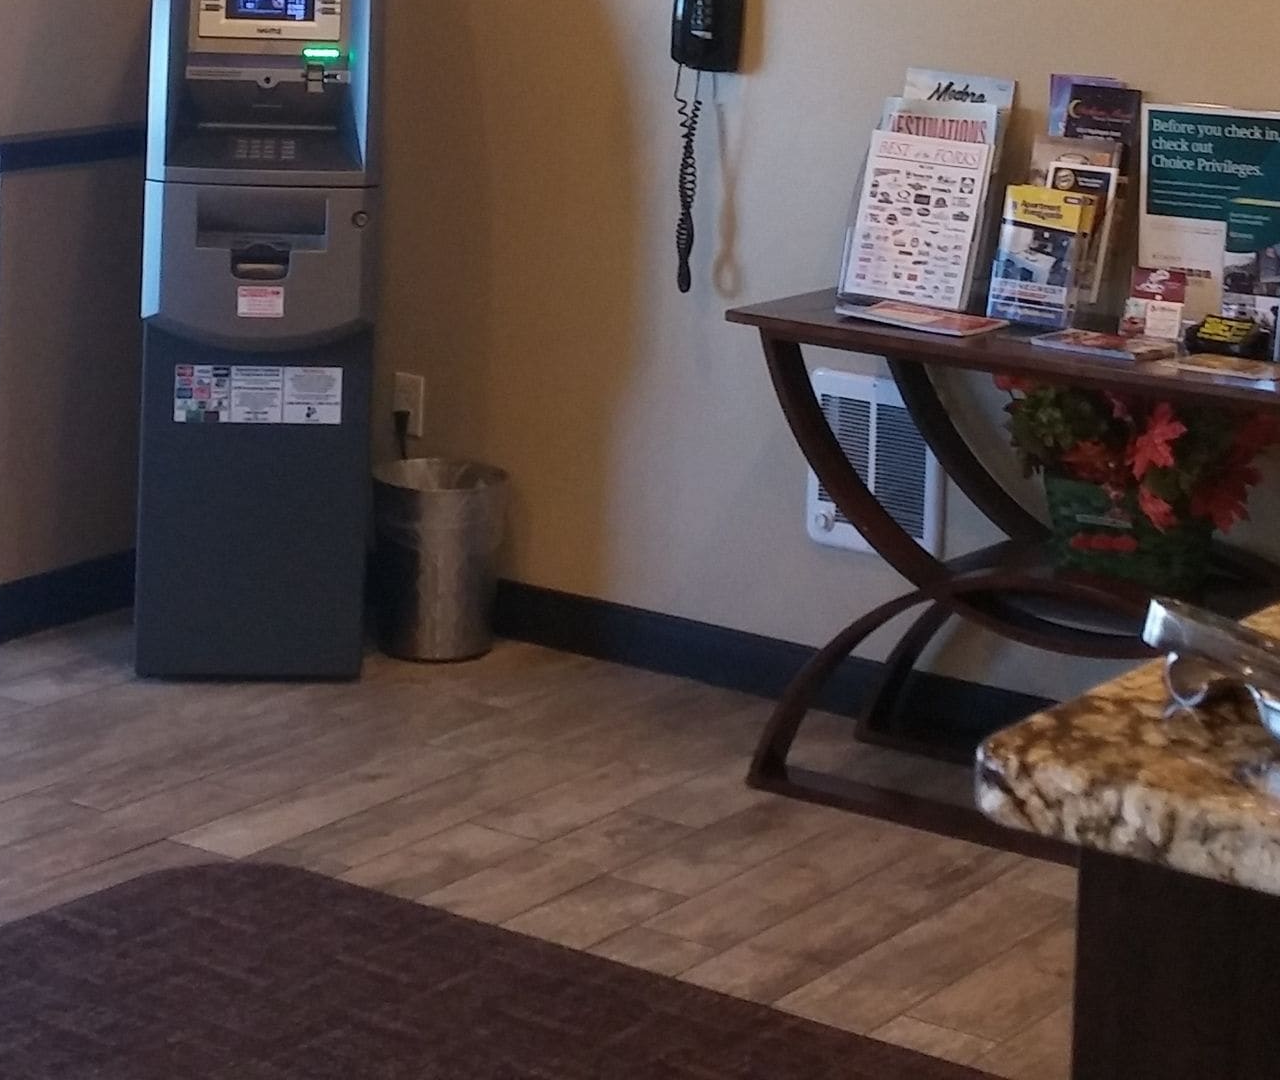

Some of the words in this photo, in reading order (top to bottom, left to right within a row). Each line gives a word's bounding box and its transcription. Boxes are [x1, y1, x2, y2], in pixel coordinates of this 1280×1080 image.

[1152, 119, 1195, 134] Before
[1197, 124, 1222, 138] you
[1224, 124, 1262, 139] check
[1151, 137, 1189, 153] check
[1191, 141, 1214, 154] out
[1151, 155, 1195, 170] Choice
[1197, 157, 1264, 179] Privileges.
